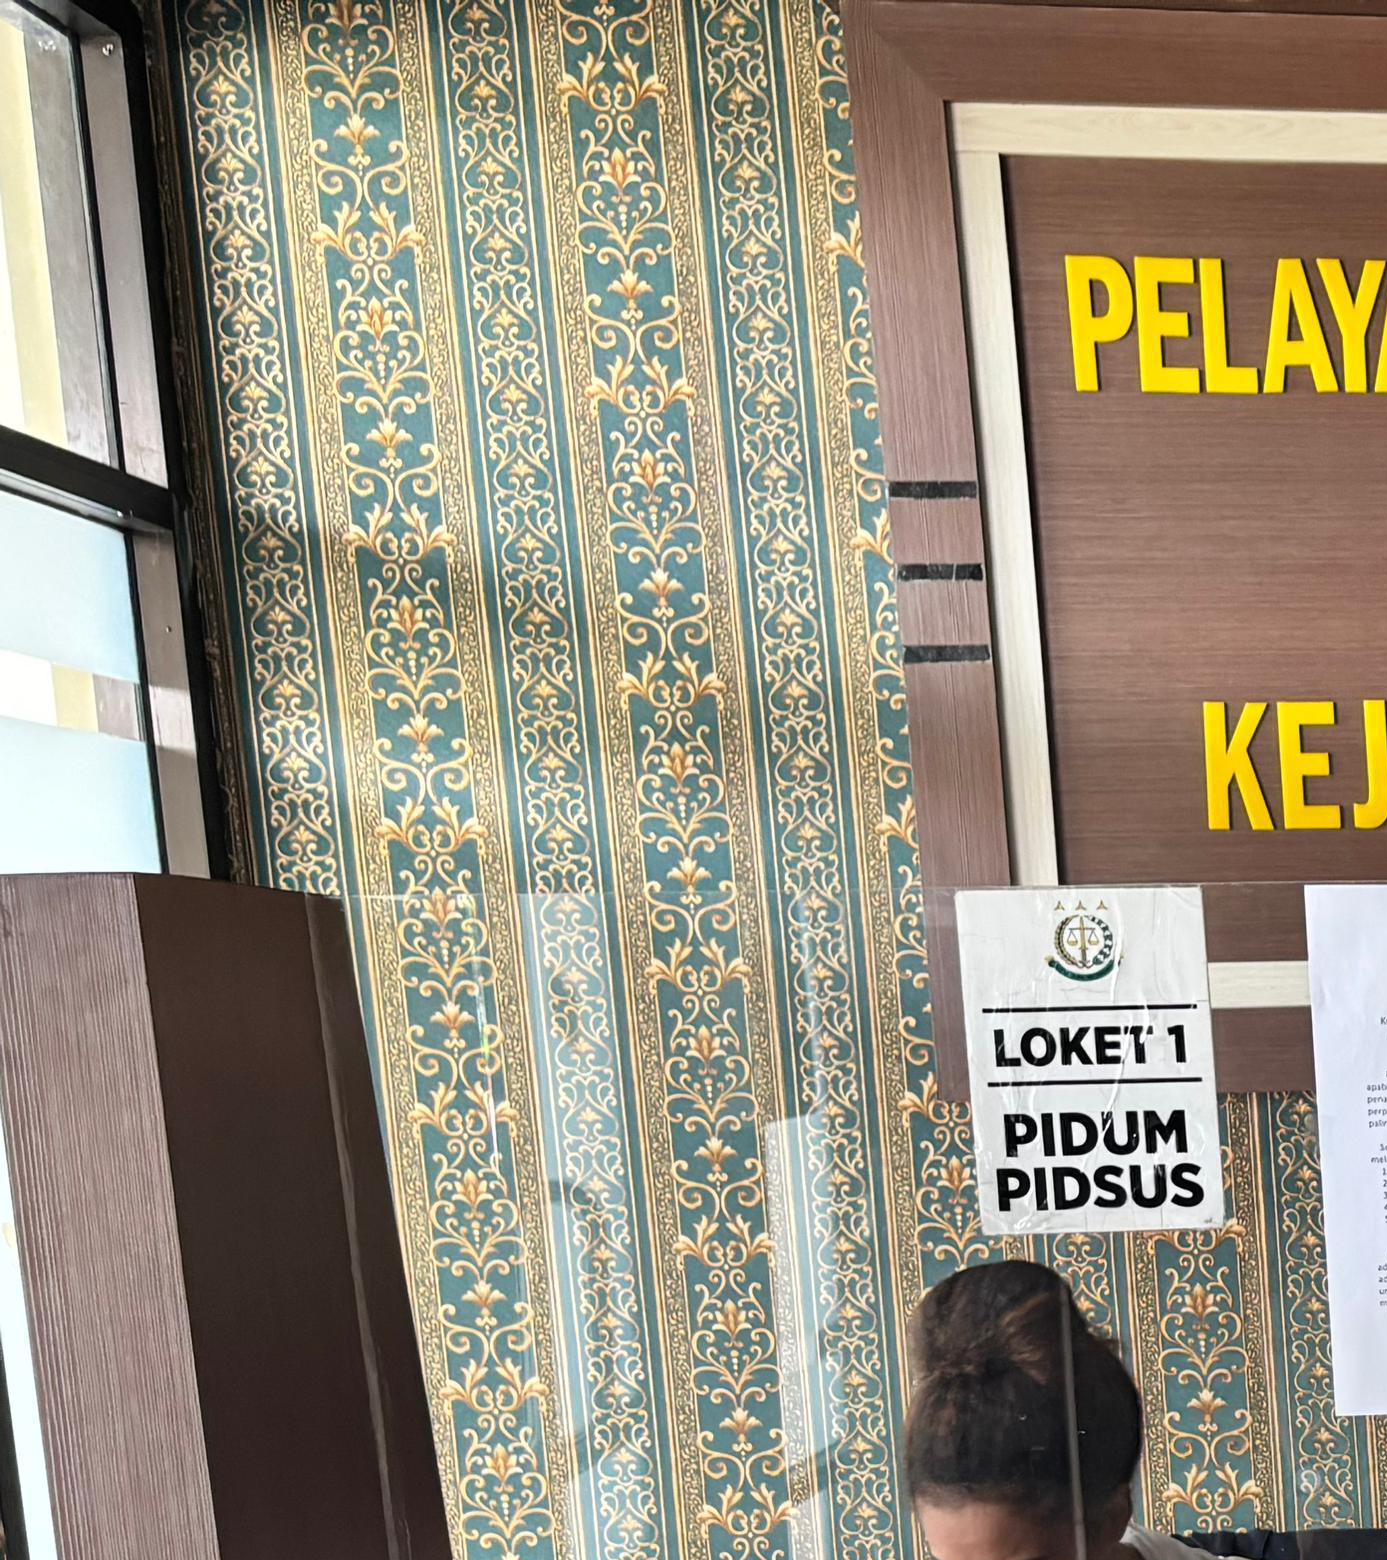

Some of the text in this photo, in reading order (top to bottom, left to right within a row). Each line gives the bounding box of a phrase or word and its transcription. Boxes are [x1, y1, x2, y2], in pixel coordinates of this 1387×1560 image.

[993, 1024, 1187, 1068] LOKET 1
[1003, 1109, 1189, 1158] PIDUM
[996, 1162, 1205, 1212] PIDSUS
